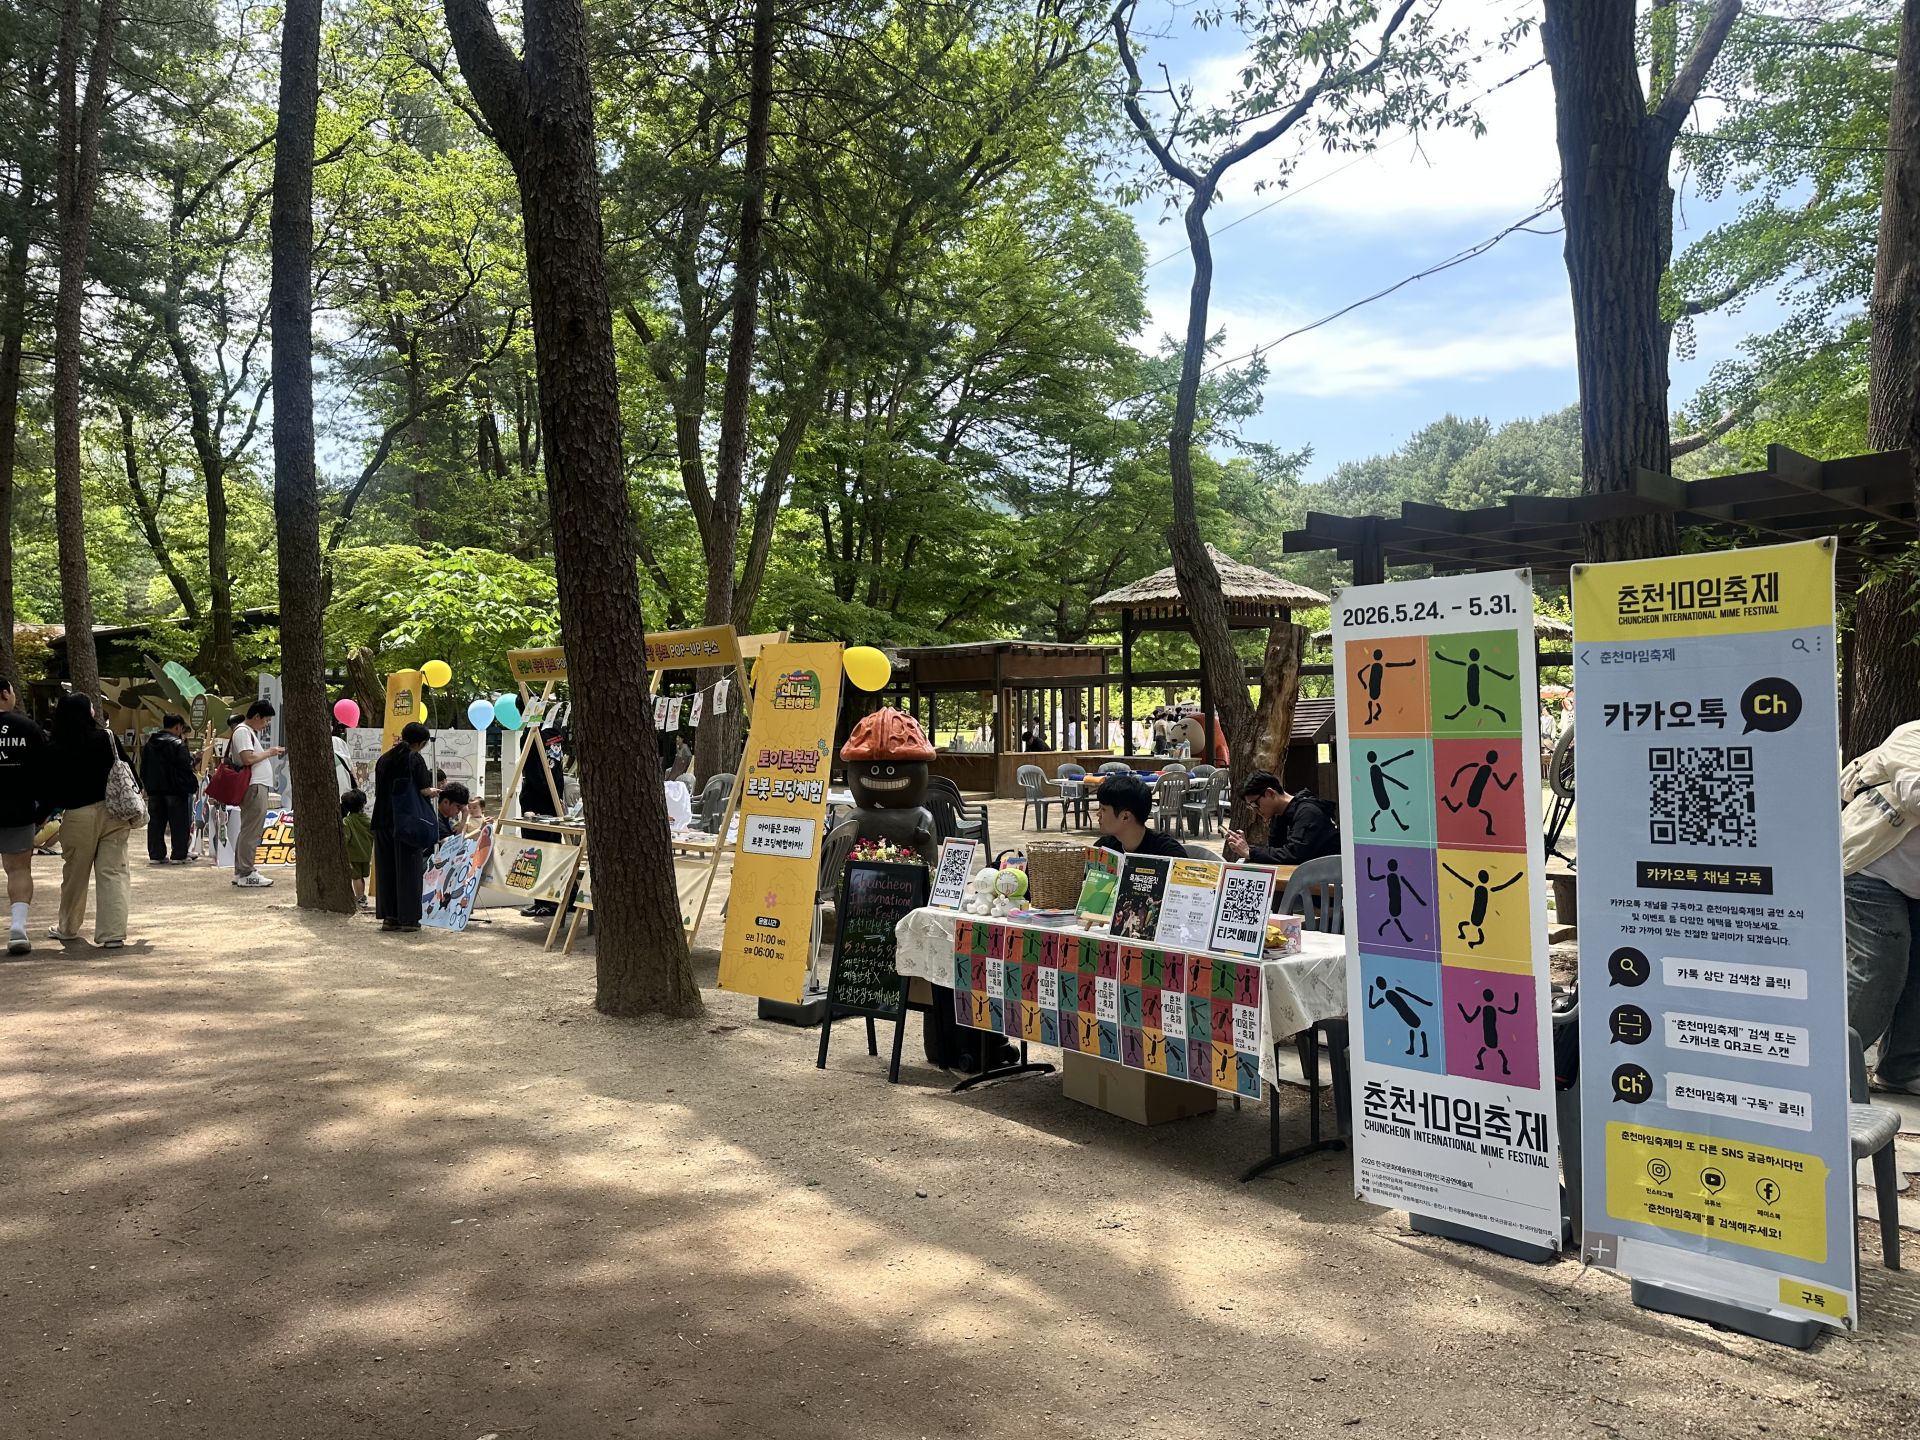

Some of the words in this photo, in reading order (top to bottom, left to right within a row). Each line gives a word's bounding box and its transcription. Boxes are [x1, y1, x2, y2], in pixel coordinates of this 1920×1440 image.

[1342, 600, 1445, 627] 2026.5.24.
[1469, 594, 1517, 616] 5.31.
[1618, 613, 1660, 626] CHUNCHEON
[1661, 609, 1717, 623] INTERNATIONAL
[1719, 607, 1741, 618] MIME
[1743, 604, 1780, 616] FESTIVAL
[669, 641, 702, 657] POP-UP
[1599, 647, 1676, 664] 춘천마임축제
[1603, 697, 1728, 731] 카카오톡
[1753, 693, 1788, 715] Ch
[757, 748, 820, 774] 토이로봇관
[746, 777, 771, 800] 로봇
[771, 778, 824, 804] 코딩체험
[757, 822, 782, 834] 아이들은
[751, 837, 763, 848] 로봇
[1646, 868, 1698, 882] 카카오톡
[1702, 870, 1730, 884] 채널
[1735, 871, 1763, 886] 구독
[1610, 898, 1641, 909] 카카오톡
[1644, 900, 1668, 911] 채널을
[1671, 901, 1704, 912] 구독하고
[1706, 904, 1764, 917] 춘천마임축제의
[1767, 907, 1784, 918] 공연
[1787, 909, 1804, 920] 소식
[1642, 913, 1666, 923] 이벤트
[1680, 915, 1704, 926] 다양한
[756, 932, 776, 945] 11:00
[1216, 925, 1258, 944] 티켓예매
[1620, 924, 1636, 934] 가장
[1638, 926, 1662, 936] 가까이
[1664, 927, 1681, 938] 있는
[1684, 928, 1708, 940] 친절한
[1711, 931, 1744, 943] 알리미가
[1746, 934, 1791, 946] 되겠습니다.
[753, 946, 775, 959] 06:00
[1677, 968, 1699, 980] 카톡
[1703, 970, 1725, 983] 상단
[1728, 972, 1761, 987] 검색창
[1764, 976, 1791, 990] 클릭!
[1679, 1034, 1721, 1048] 스캐너로
[1723, 1039, 1764, 1054] QR코드
[1767, 1045, 1790, 1059] 스캔
[1747, 1028, 1770, 1042] 검색
[1774, 1031, 1797, 1045] 또는
[1674, 1084, 1738, 1106] 춘천마임축제
[1778, 1102, 1805, 1117] 클릭!
[1364, 1119, 1411, 1139] CHUNCHEON
[1413, 1129, 1477, 1154] INTERNATIONAL
[1480, 1143, 1504, 1160] MIME
[1508, 1149, 1550, 1169] FESTIVAL
[1621, 1130, 1683, 1150] 춘천마임축제의
[1685, 1141, 1696, 1151] 또
[1699, 1143, 1718, 1155] 다른
[1721, 1147, 1744, 1160] SNS
[1746, 1151, 1804, 1173] 궁금하시다면
[1360, 1156, 1375, 1166] 2026
[1718, 1217, 1783, 1240] 검색해주세요!
[1801, 1290, 1826, 1308] 구독
